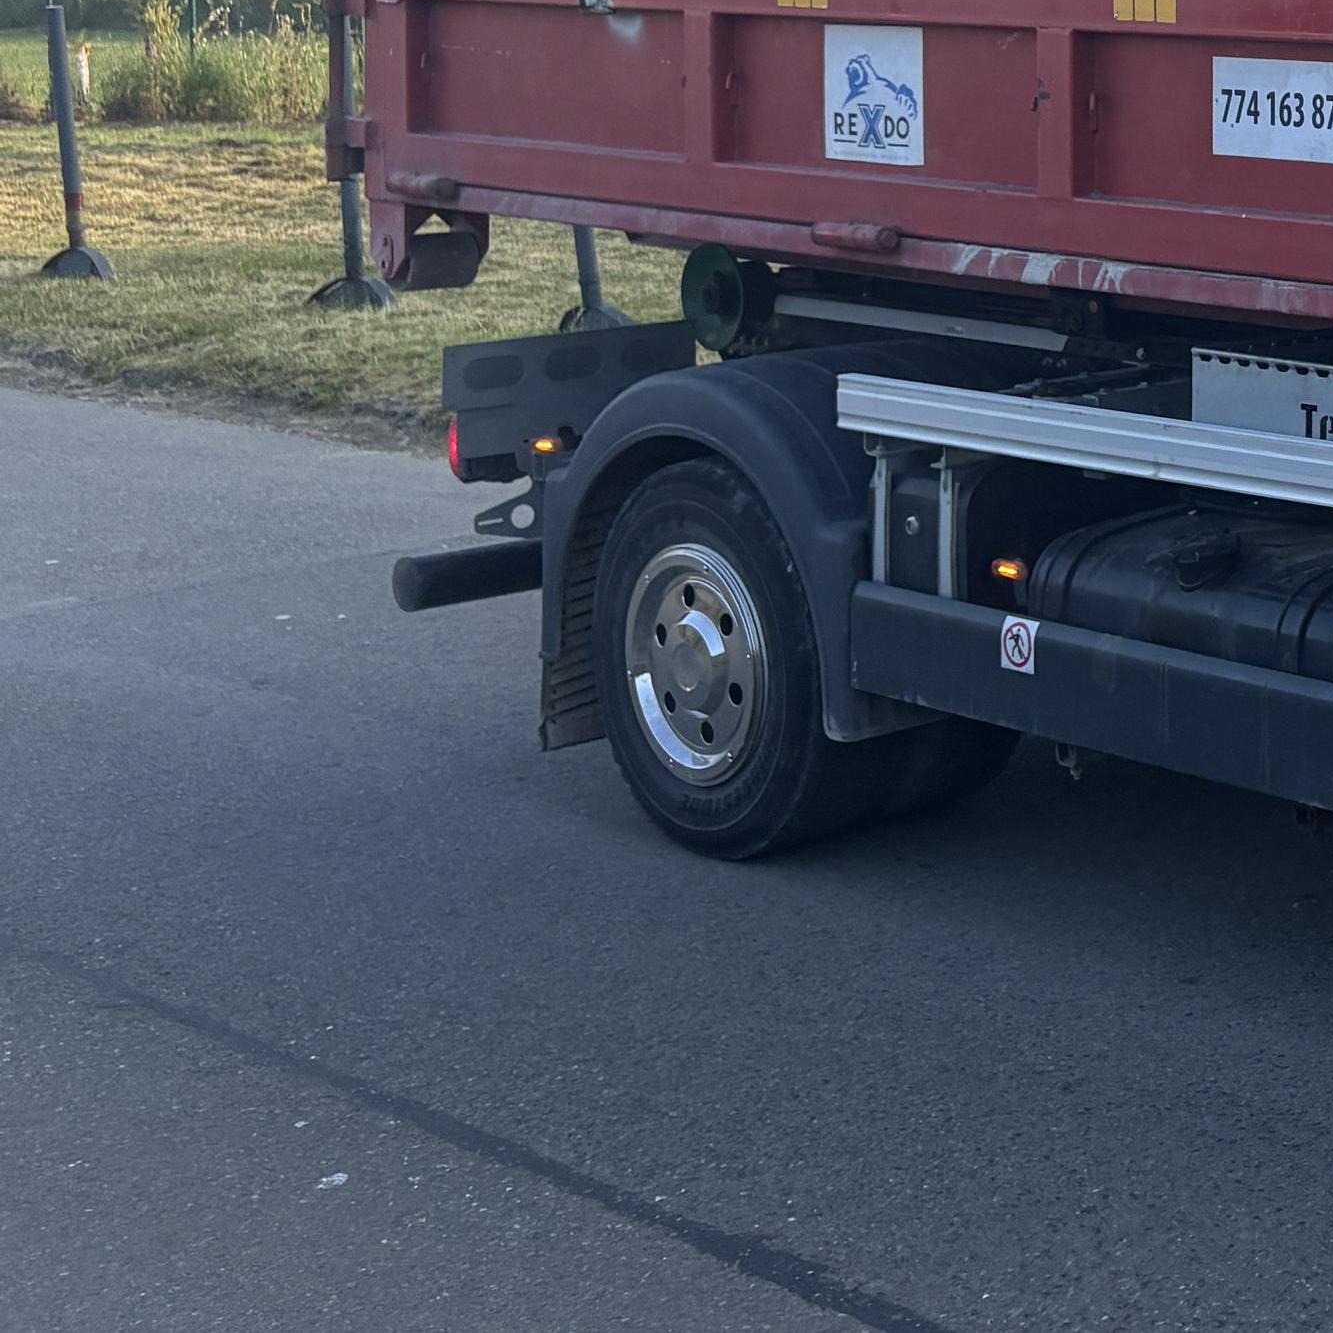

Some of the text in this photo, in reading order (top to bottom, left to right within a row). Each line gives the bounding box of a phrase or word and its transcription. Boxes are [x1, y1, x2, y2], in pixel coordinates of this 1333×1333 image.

[834, 103, 910, 149] REXDO
[1221, 89, 1260, 125] 774
[1266, 91, 1305, 129] 163
